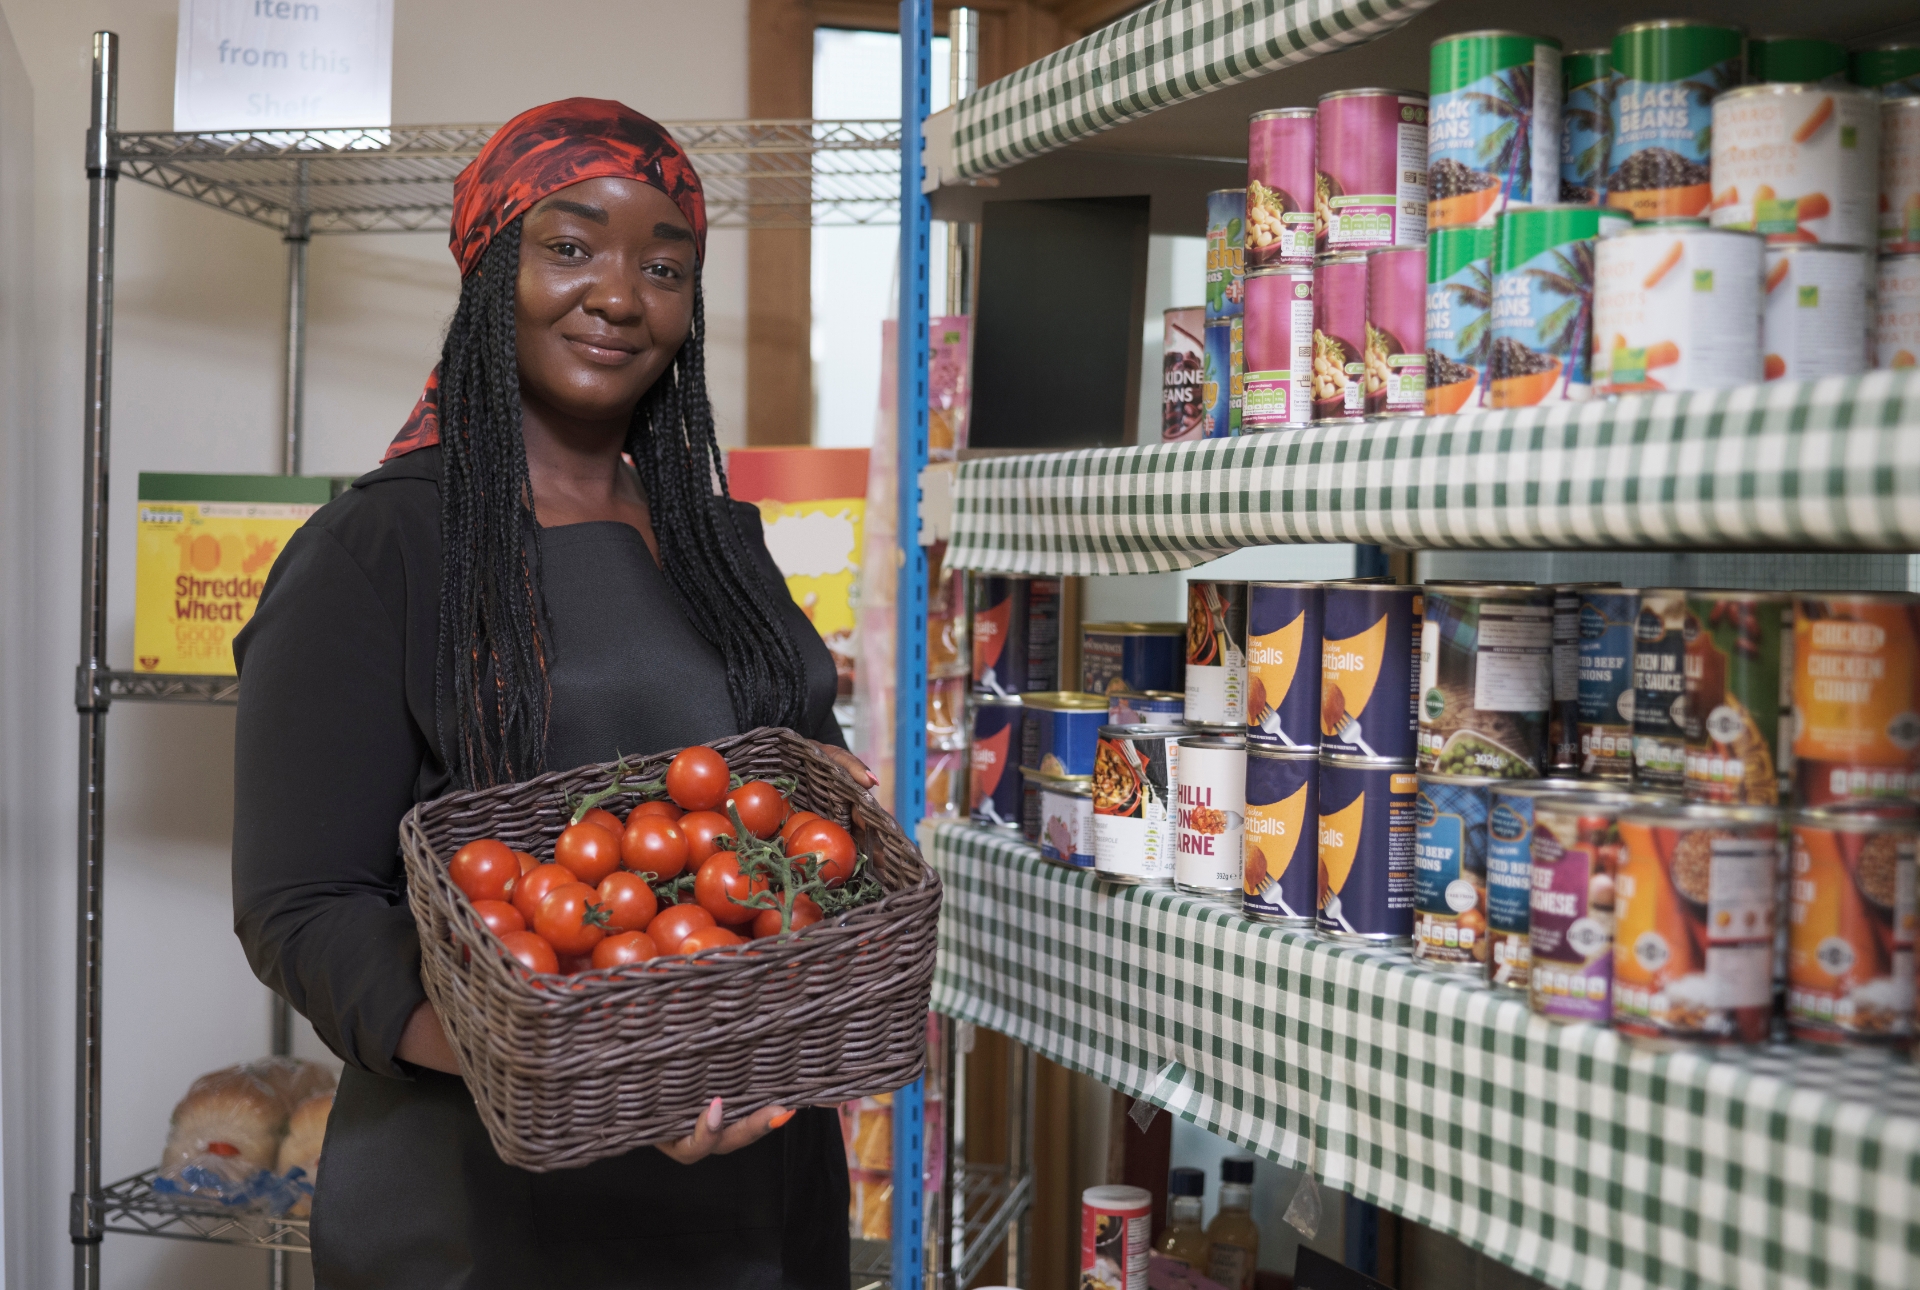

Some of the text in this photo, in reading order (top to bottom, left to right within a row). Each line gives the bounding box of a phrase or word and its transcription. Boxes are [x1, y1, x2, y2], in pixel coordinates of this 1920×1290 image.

[255, 0, 320, 21] item
[217, 38, 351, 75] from this
[246, 92, 322, 118] Shelf
[1621, 88, 1690, 112] BLACK
[1620, 110, 1689, 133] BEANS
[1432, 330, 1454, 341] WATER
[1165, 369, 1204, 385] KIDNE
[174, 598, 244, 622] Wheat
[1594, 656, 1625, 668] BEEF
[1645, 673, 1682, 691] SAUCE
[1474, 753, 1500, 769] 392g
[1178, 784, 1211, 807] HILLI
[1176, 832, 1214, 856] ARNE
[1426, 845, 1453, 860] BEEF
[1216, 872, 1229, 881] 392g
